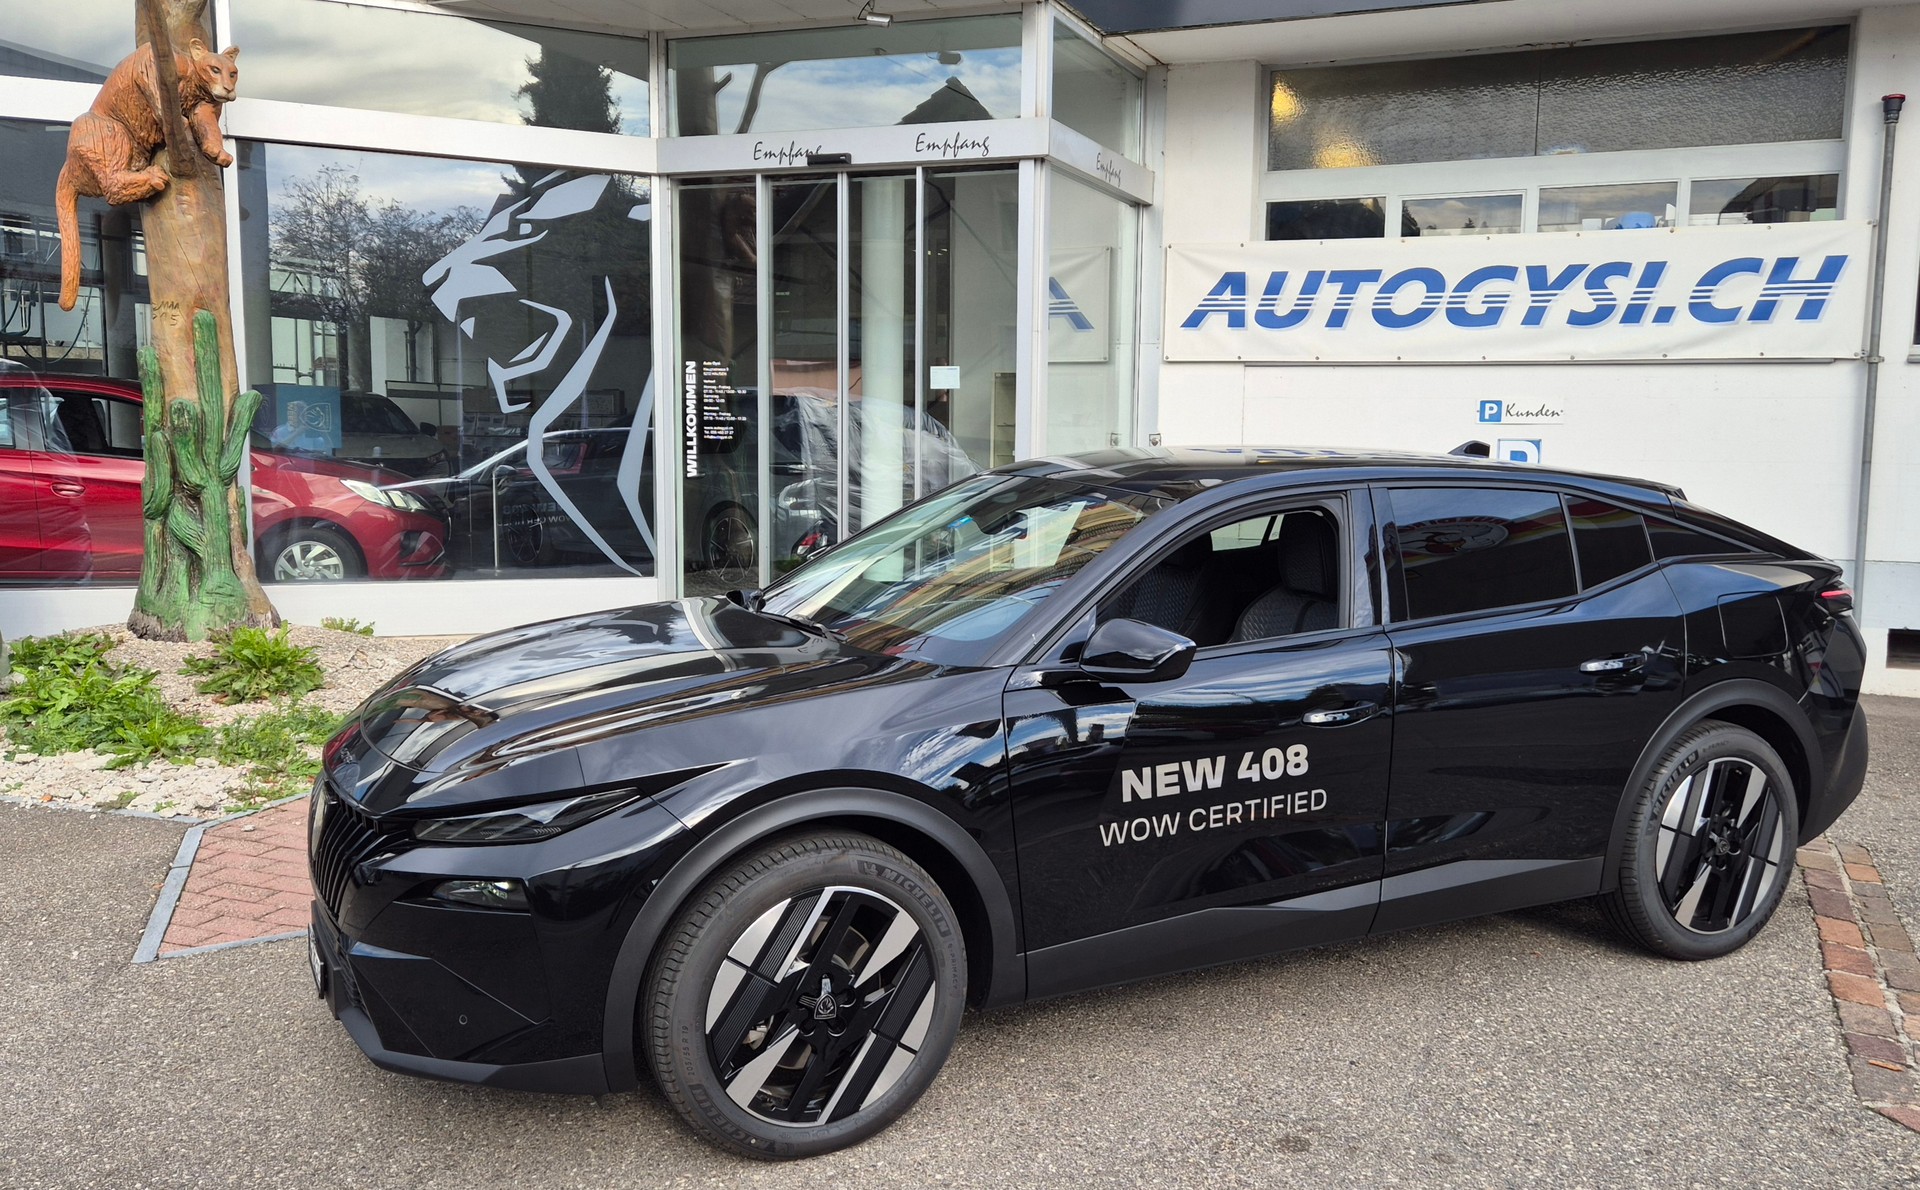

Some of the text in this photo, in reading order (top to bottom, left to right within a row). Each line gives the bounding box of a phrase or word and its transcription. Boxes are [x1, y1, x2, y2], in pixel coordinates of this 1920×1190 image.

[915, 132, 990, 157] Empfang
[1180, 255, 1849, 329] AUTOGYSI.CH
[685, 361, 697, 478] WILLKOMMEN
[1505, 403, 1560, 417] Kunden
[1122, 744, 1309, 803] NEW 408
[1653, 752, 1698, 815] MICHELIN
[1100, 789, 1327, 847] WOW CERTIFIED
[881, 867, 947, 932] MICHELIN
